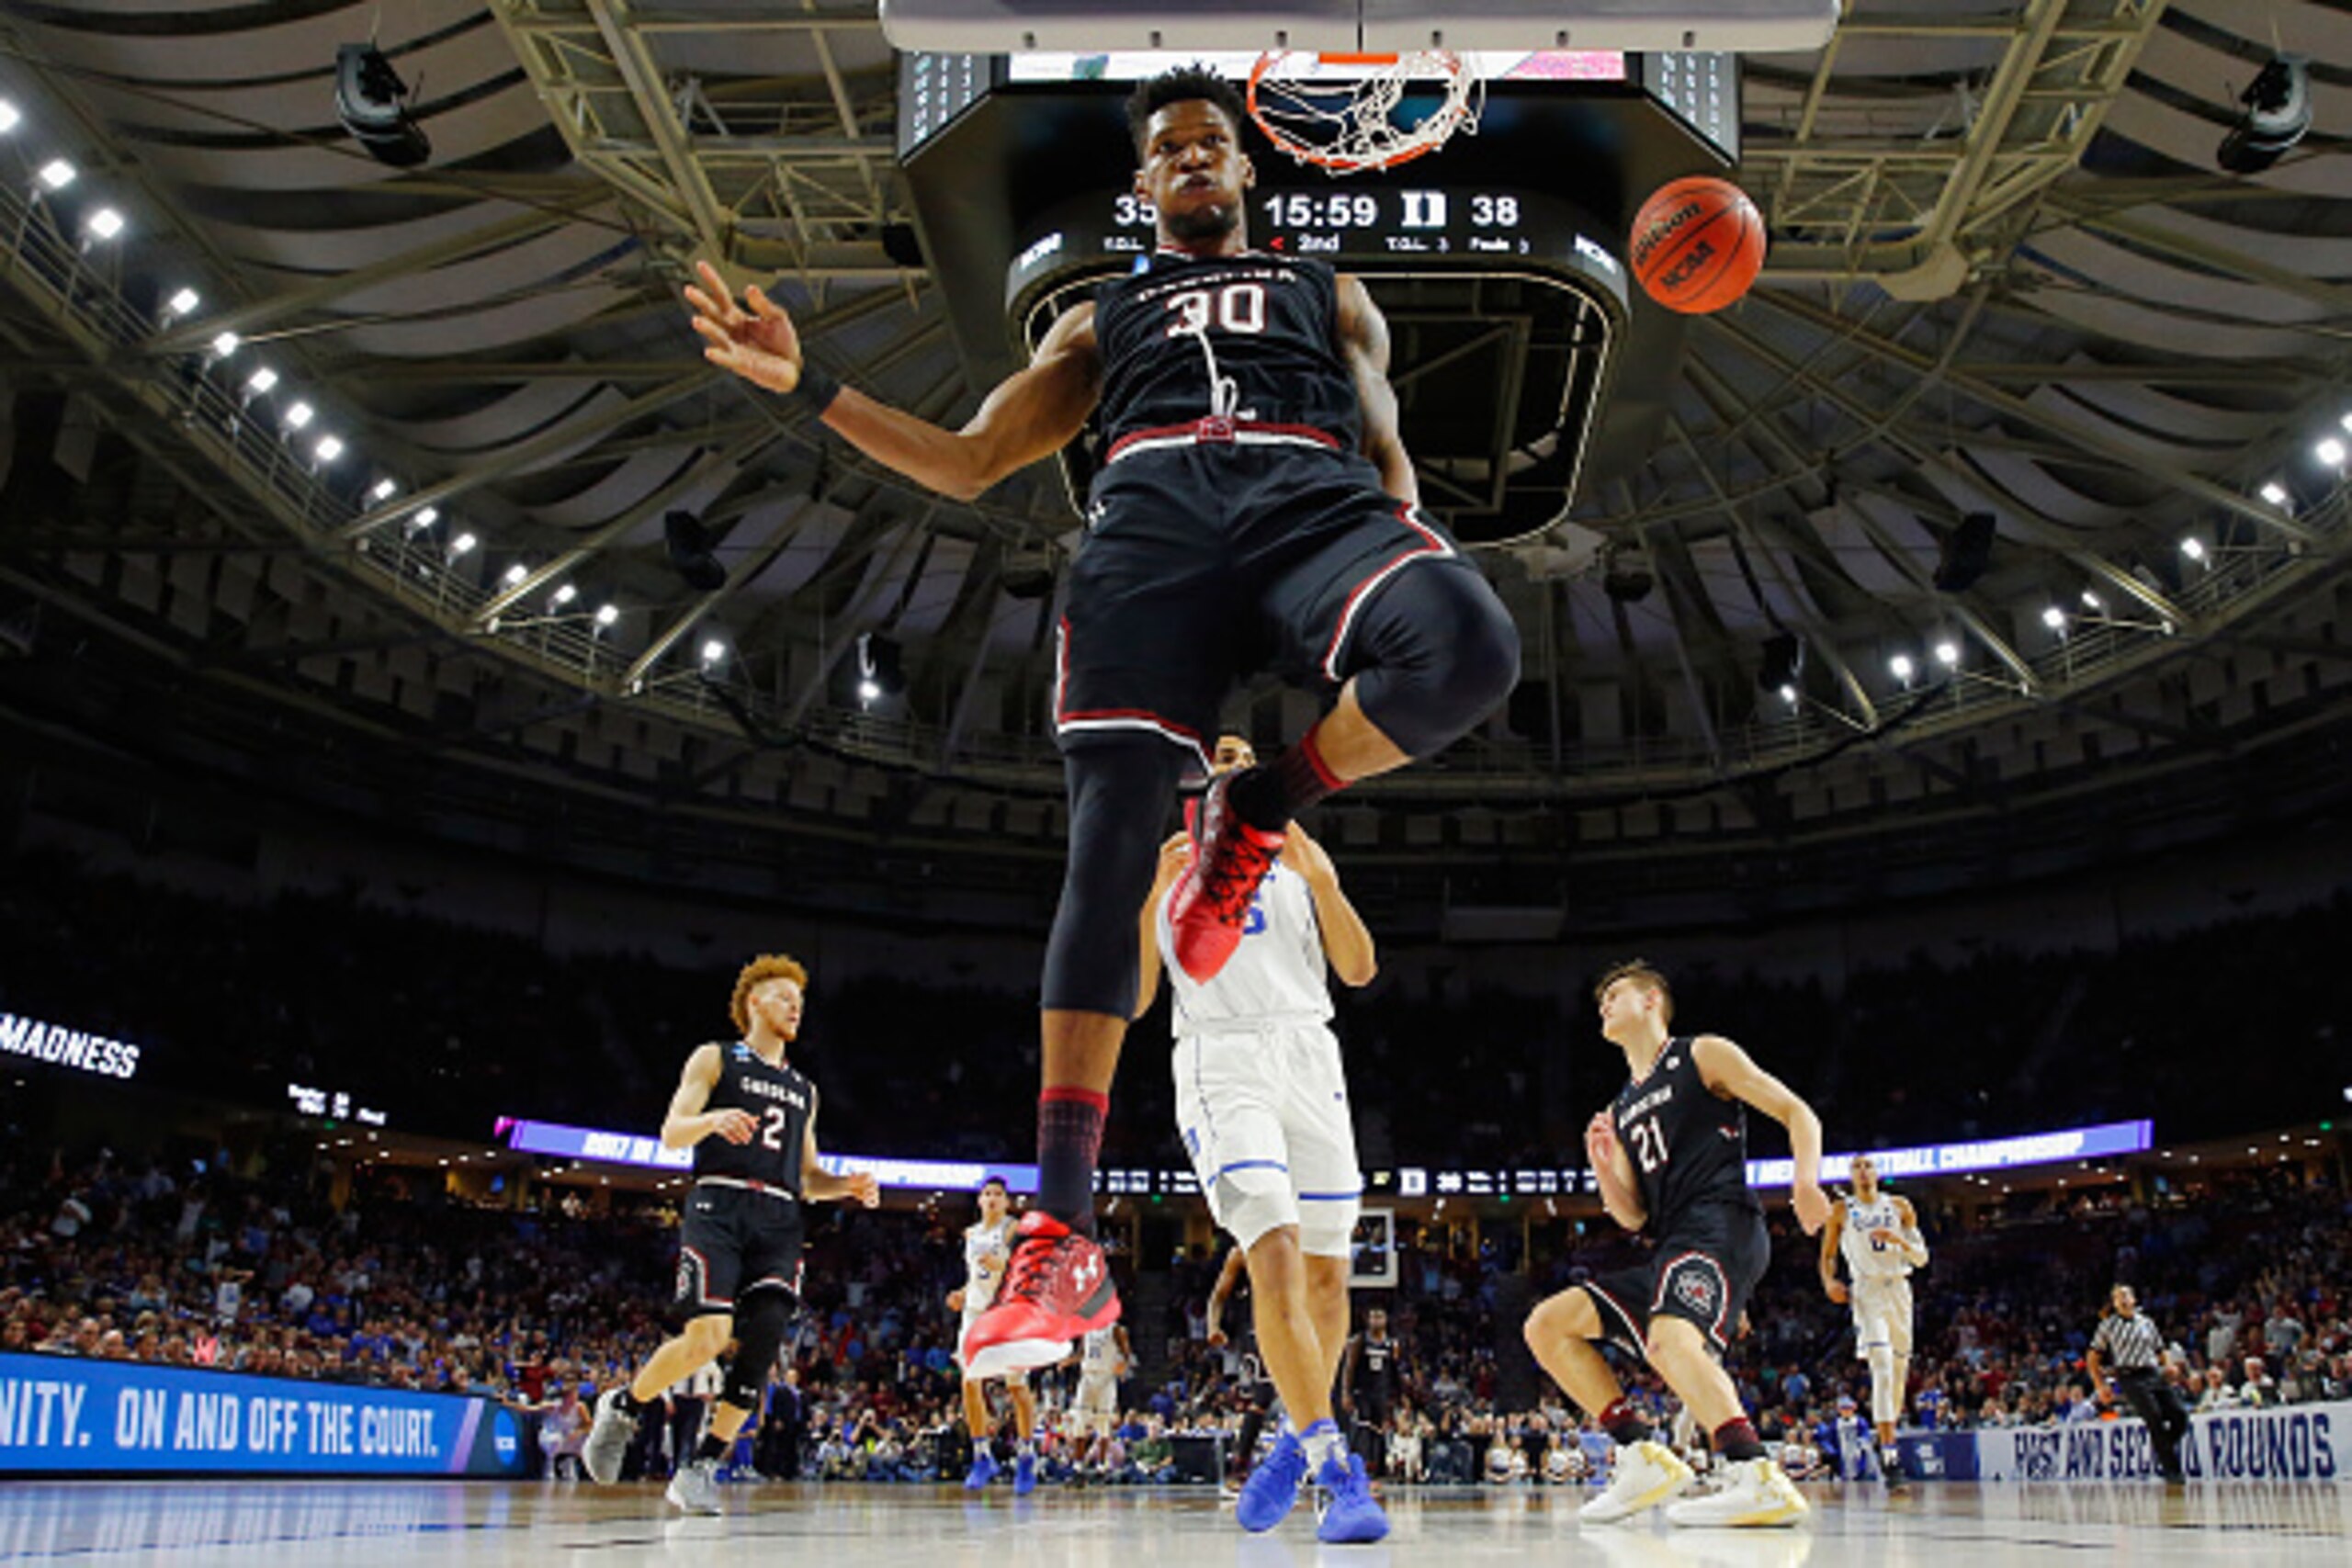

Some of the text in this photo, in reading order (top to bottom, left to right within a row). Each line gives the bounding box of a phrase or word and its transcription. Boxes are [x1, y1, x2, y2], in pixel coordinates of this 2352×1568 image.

[1263, 194, 1378, 227] 15:59
[1472, 195, 1519, 227] 38
[1297, 232, 1341, 252] 2nd
[1659, 239, 1716, 293] NCAA
[1165, 282, 1267, 339] 30
[0, 1012, 141, 1079] MADNESS
[761, 1105, 786, 1151] 2
[1630, 1114, 1669, 1173] 21
[115, 1387, 167, 1450] ON
[173, 1391, 240, 1451] AND
[247, 1395, 300, 1455] OFF
[307, 1401, 354, 1455] THE
[358, 1404, 439, 1459] COURT.
[2207, 1412, 2336, 1479] ROUNDS
